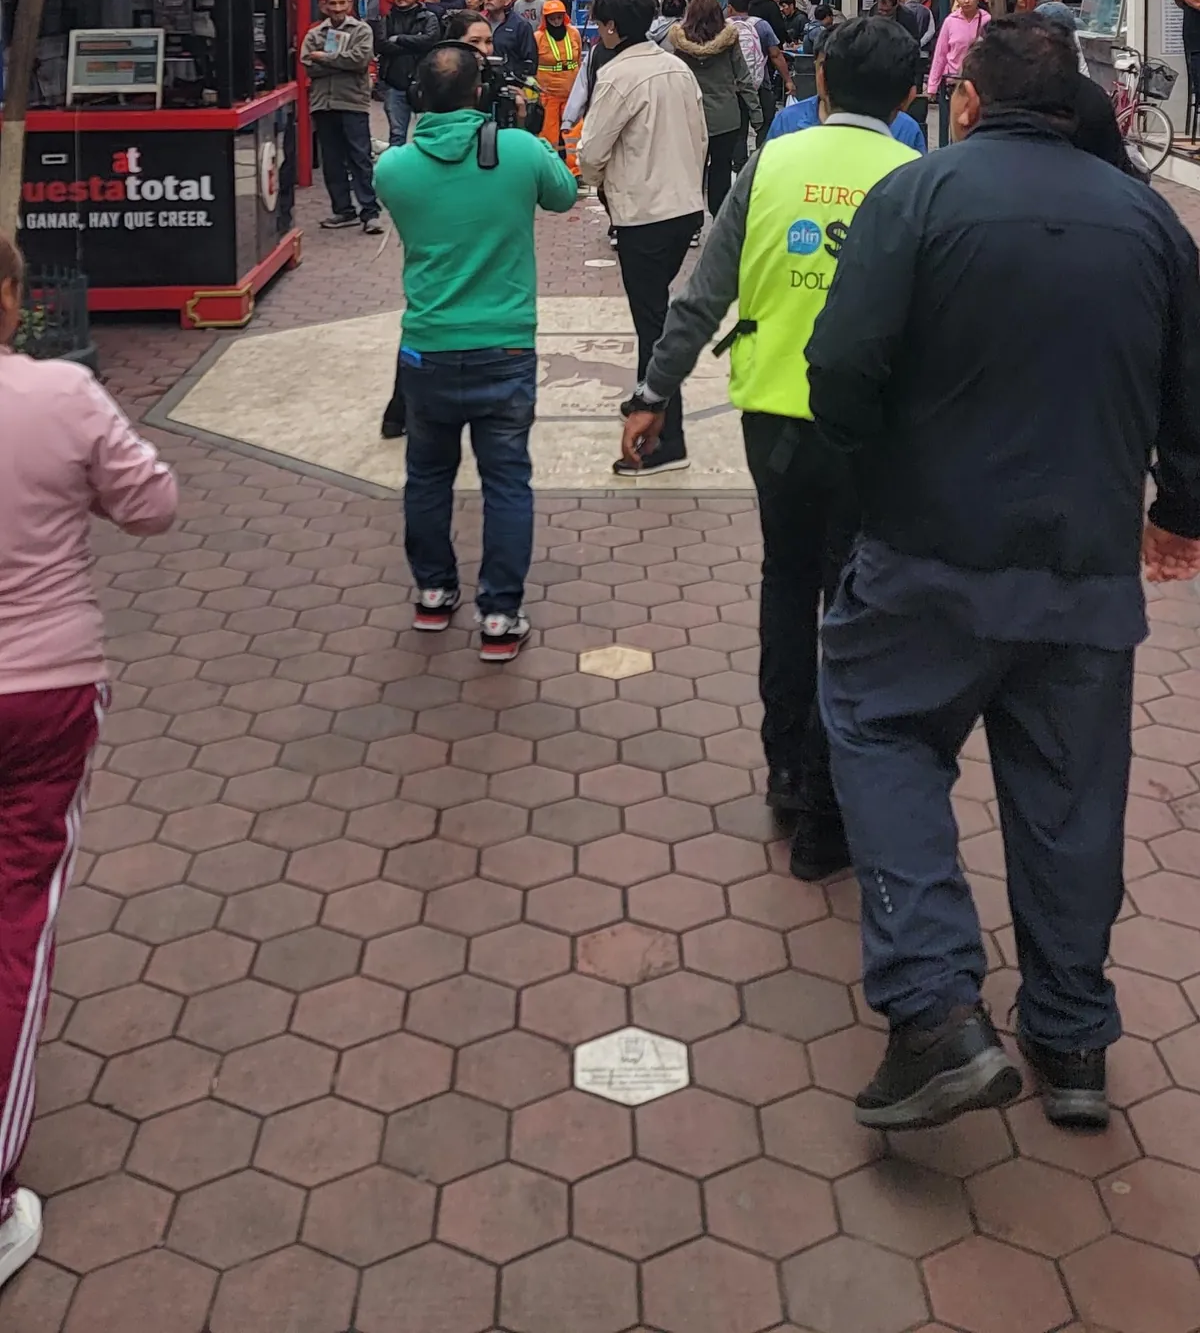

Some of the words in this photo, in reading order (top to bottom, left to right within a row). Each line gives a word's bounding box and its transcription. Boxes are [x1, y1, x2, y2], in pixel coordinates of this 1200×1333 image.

[112, 147, 141, 173] at
[22, 175, 215, 202] uestatotal
[26, 212, 85, 230] GANAR,
[88, 212, 121, 228] HAY
[124, 211, 154, 230] QUE
[158, 211, 213, 227] CREER.
[790, 229, 819, 243] plin
[790, 270, 829, 290] DOL
